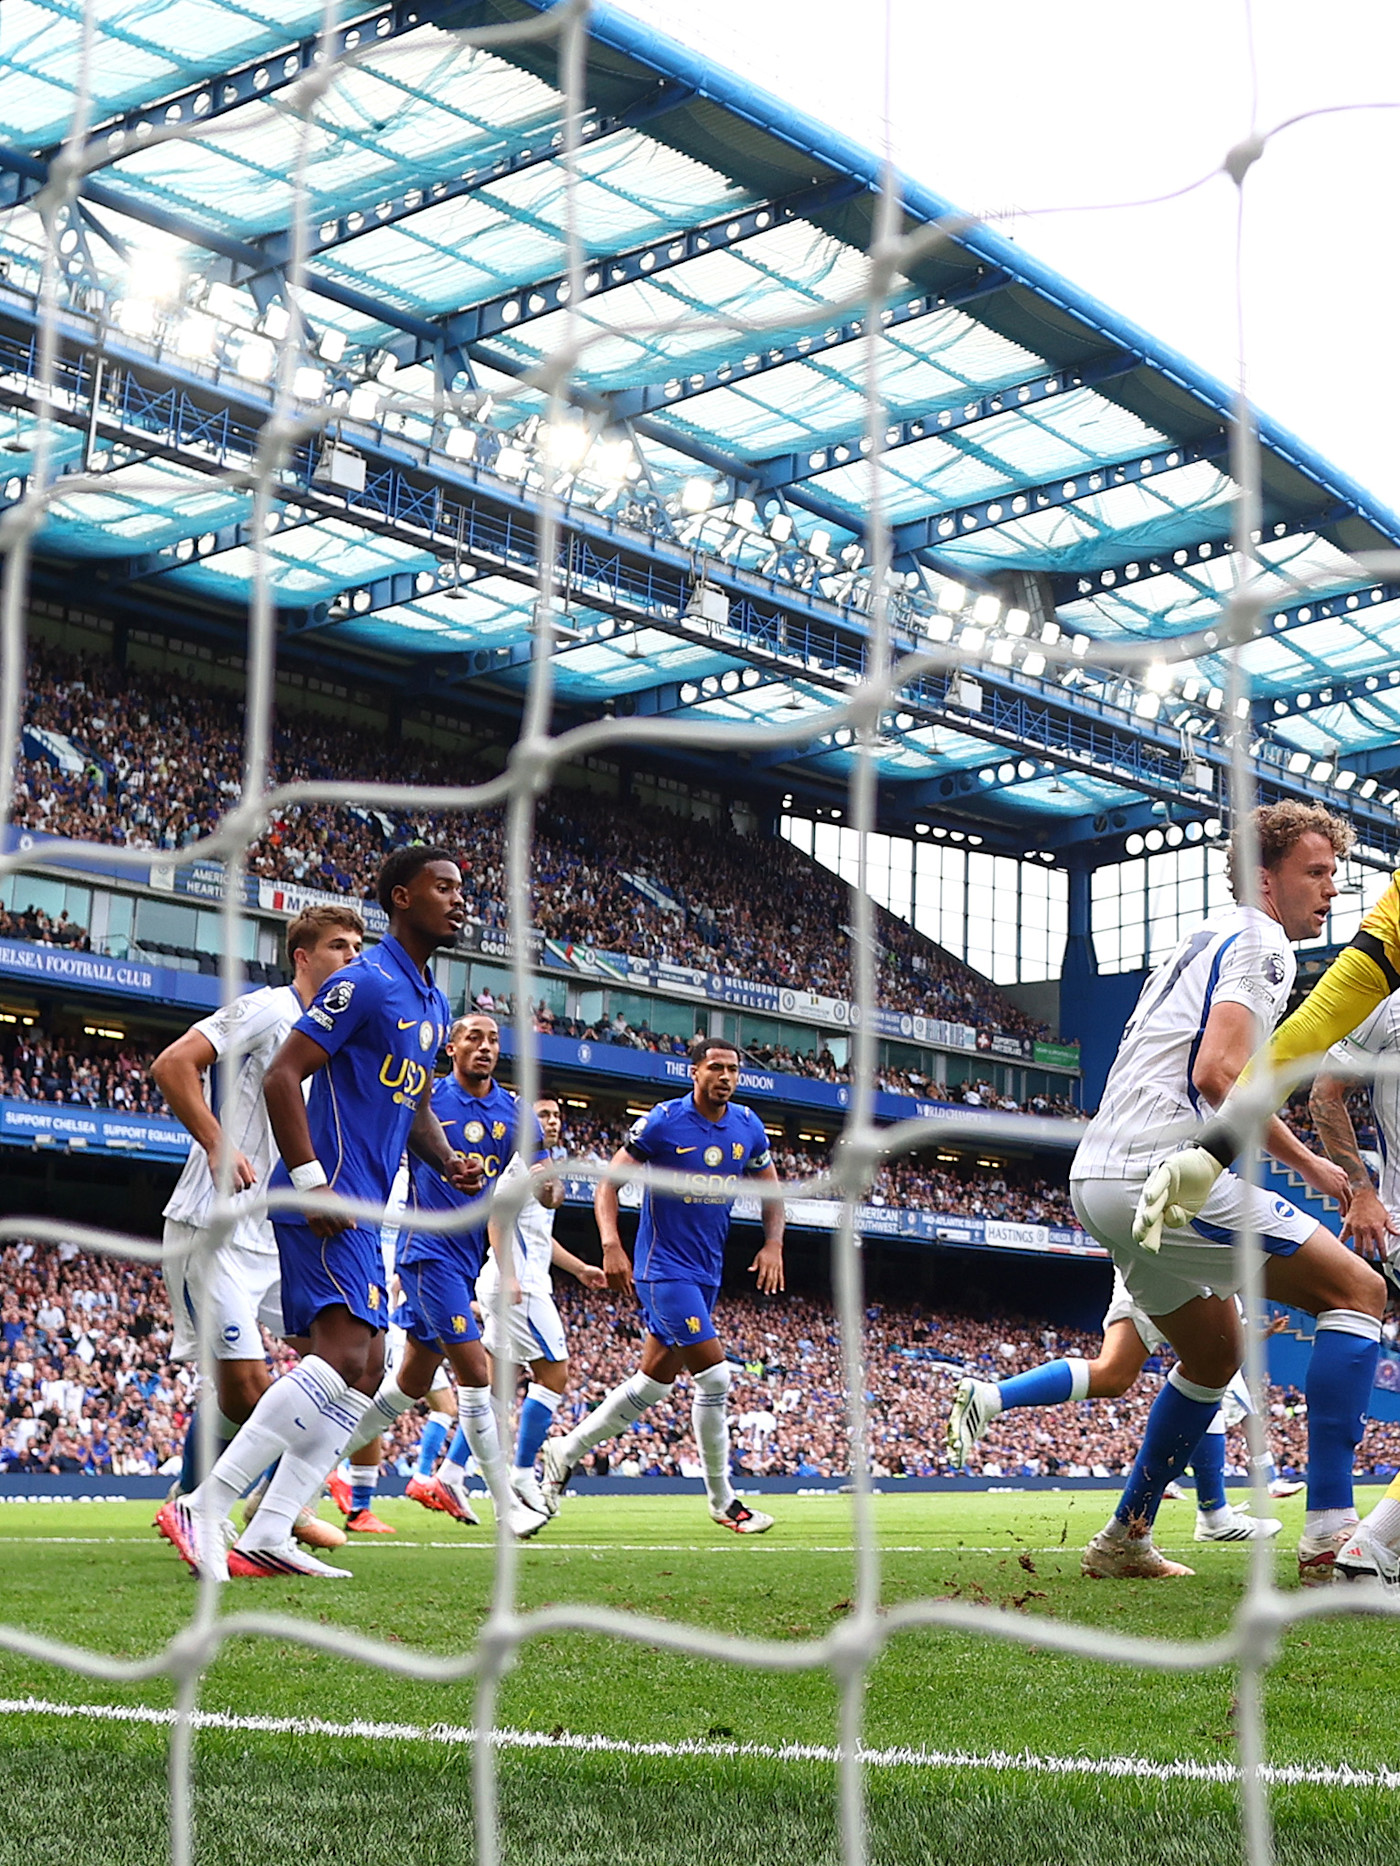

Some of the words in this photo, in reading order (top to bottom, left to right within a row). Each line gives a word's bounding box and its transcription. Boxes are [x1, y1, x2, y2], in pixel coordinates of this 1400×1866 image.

[186, 882, 248, 901] HEARTLD
[297, 886, 342, 902] SUPPORTERS
[46, 955, 115, 982] FOOTBALL
[116, 968, 152, 988] CLUB
[725, 977, 778, 998] MELBOURNE
[724, 991, 778, 1011] CHELSEA
[665, 1060, 685, 1076] THE
[5, 1111, 52, 1128] SUPPORT
[52, 1116, 96, 1134] CHELSEA
[102, 1123, 147, 1139] SUPPORT
[147, 1129, 192, 1145] EQUALITY
[854, 1205, 898, 1221] AMERICAN
[988, 1228, 1034, 1243] HASTINGS
